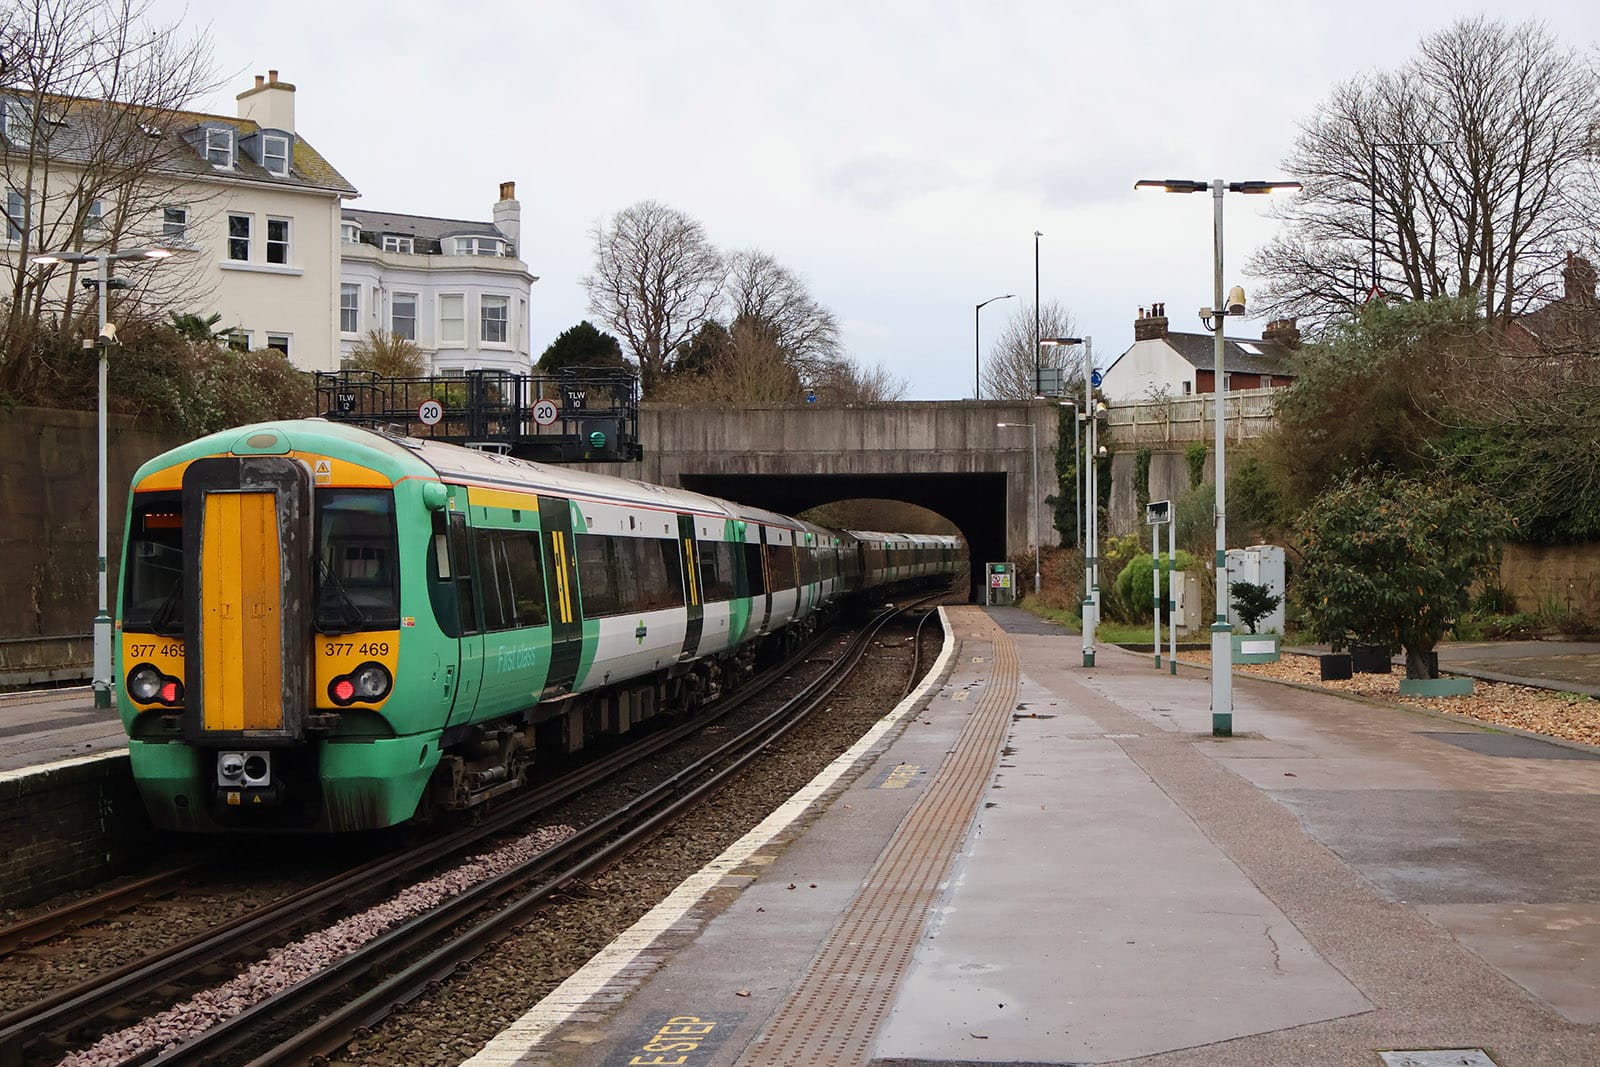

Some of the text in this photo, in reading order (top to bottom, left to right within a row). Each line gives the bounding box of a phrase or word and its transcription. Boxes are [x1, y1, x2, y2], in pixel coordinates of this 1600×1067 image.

[338, 394, 355, 402] TLW
[423, 407, 439, 419] 20
[537, 407, 553, 419] 20
[130, 644, 186, 658] 377 469
[325, 642, 389, 656] 377 469
[642, 1016, 718, 1052] STEP
